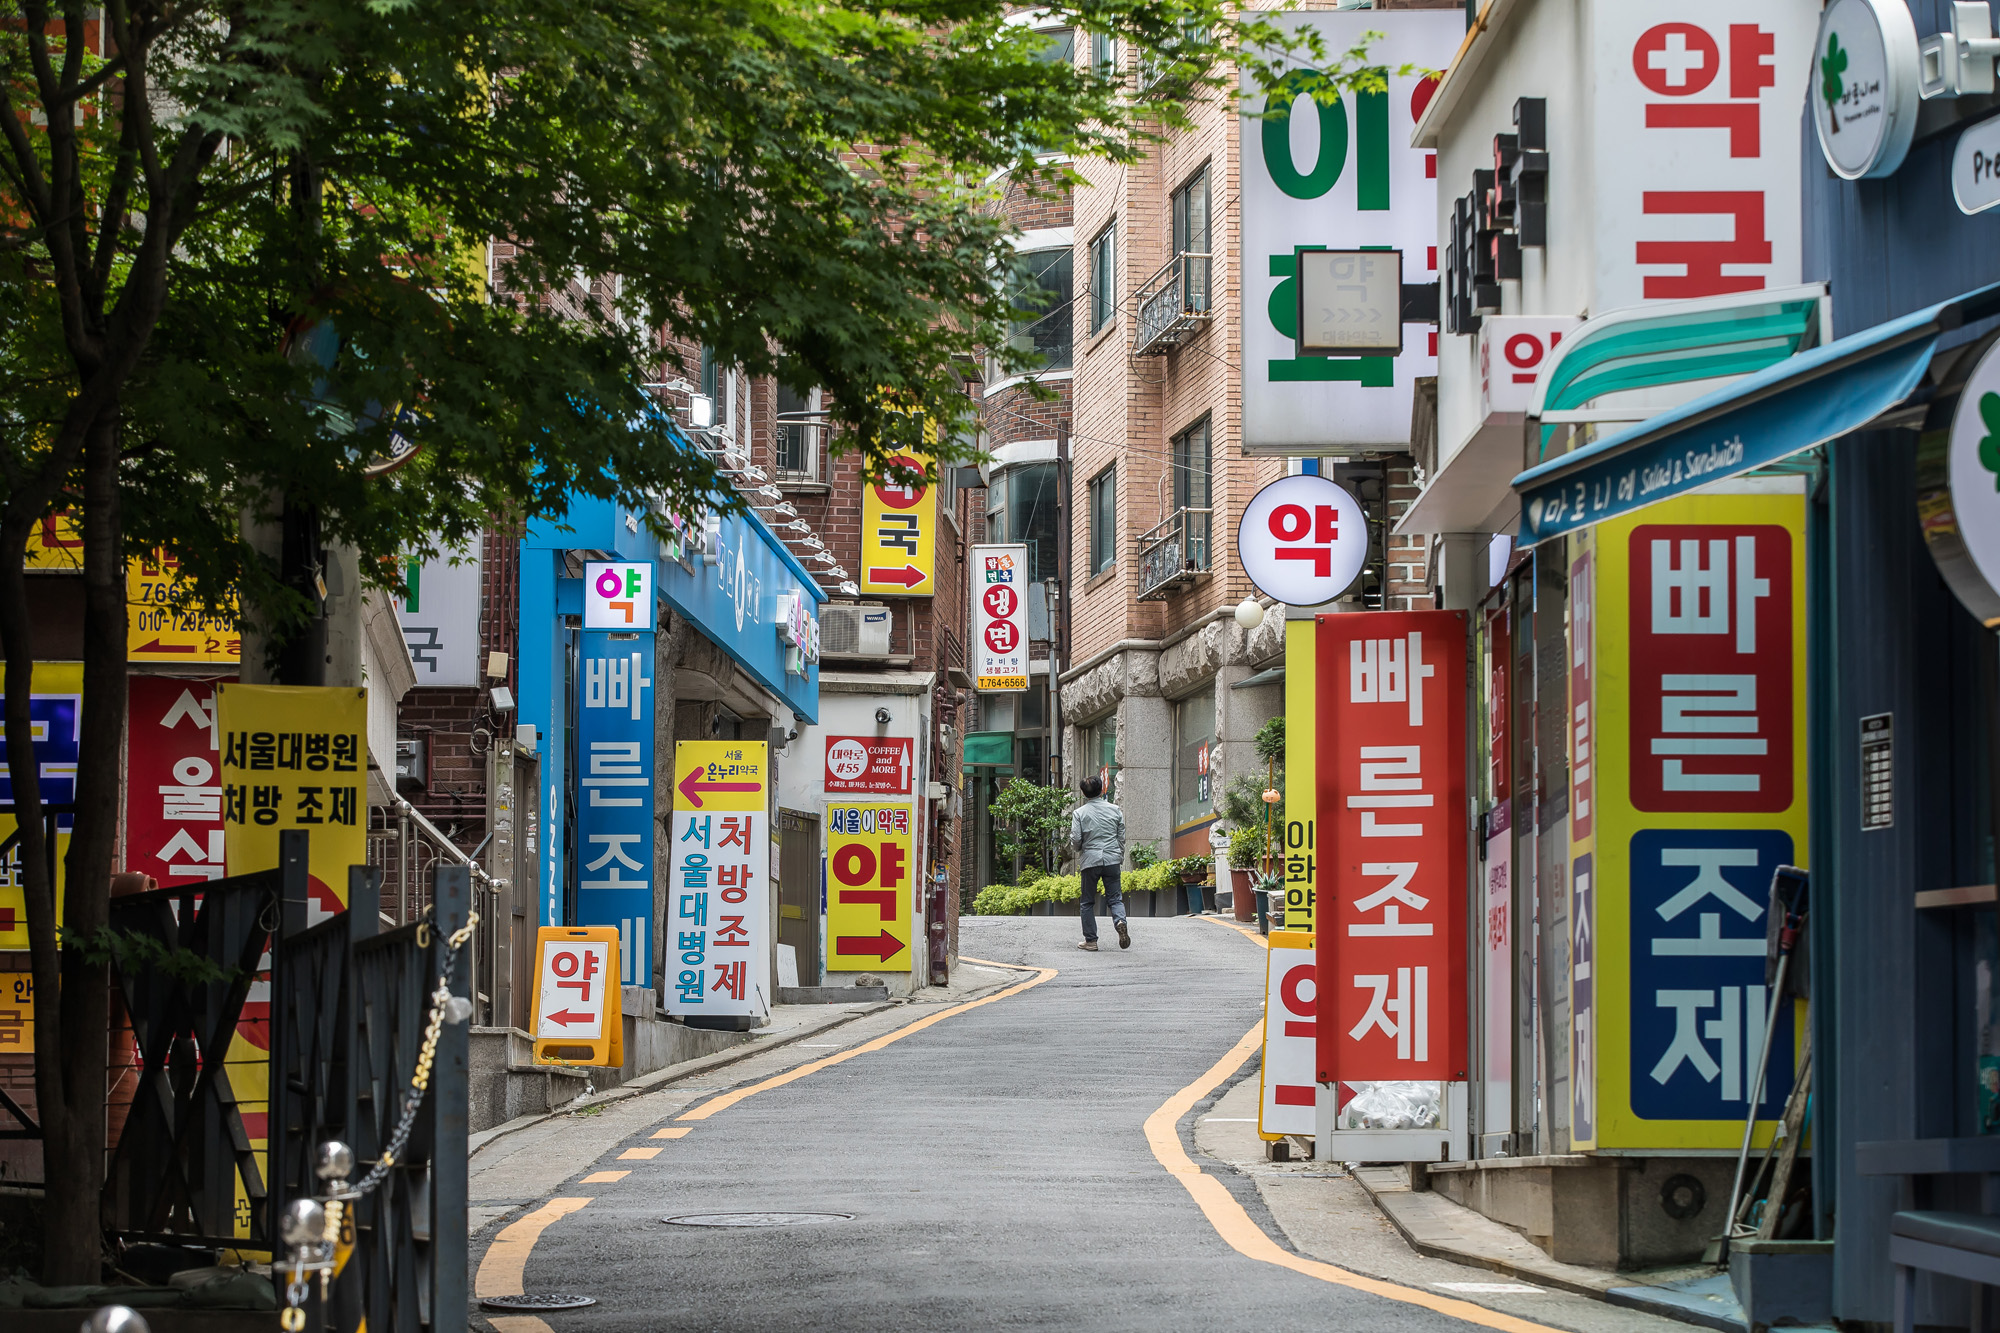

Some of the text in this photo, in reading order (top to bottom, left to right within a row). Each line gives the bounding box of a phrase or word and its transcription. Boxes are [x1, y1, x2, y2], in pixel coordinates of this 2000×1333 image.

[1633, 22, 1775, 299] 약국
[1330, 256, 1374, 302] 약
[1544, 434, 1743, 523] 마로니에 Salad & Sandwich
[988, 557, 1011, 570] 함흥
[1268, 504, 1339, 577] 약
[596, 569, 641, 623] 약
[987, 571, 1012, 582] 면옥
[988, 588, 1012, 650] 냉면
[1651, 536, 1770, 791] 빠른
[224, 731, 357, 772] 서울대병원
[707, 762, 758, 781] 온누리약국
[724, 750, 743, 760] 서울
[832, 749, 863, 760] 대학로
[836, 763, 859, 773] #55
[868, 746, 900, 755] COFFEE
[225, 784, 357, 826] 처방 조제
[830, 808, 909, 834] 서울이약국
[833, 842, 905, 921] 약
[1286, 820, 1316, 931] 이화약
[675, 815, 712, 1003] 서울대병원
[712, 816, 753, 1001] 처방조제
[552, 950, 599, 1001] 약
